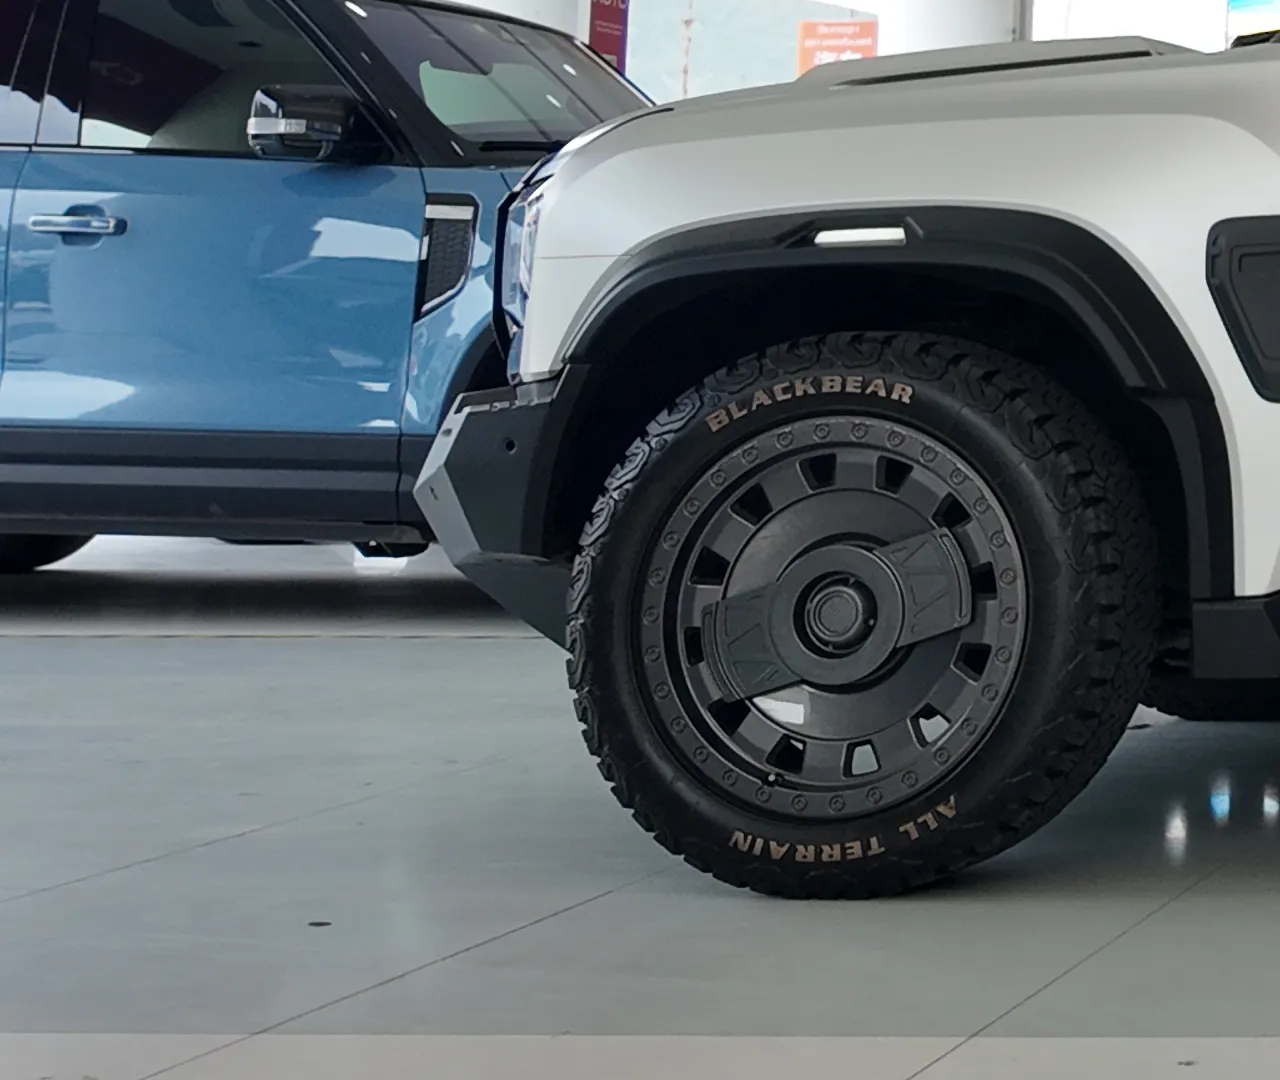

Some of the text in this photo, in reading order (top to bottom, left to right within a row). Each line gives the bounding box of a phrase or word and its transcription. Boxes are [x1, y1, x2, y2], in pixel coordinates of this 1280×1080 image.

[706, 375, 914, 433] BLACKBEAR
[728, 795, 957, 863] ALL TERRAIN
